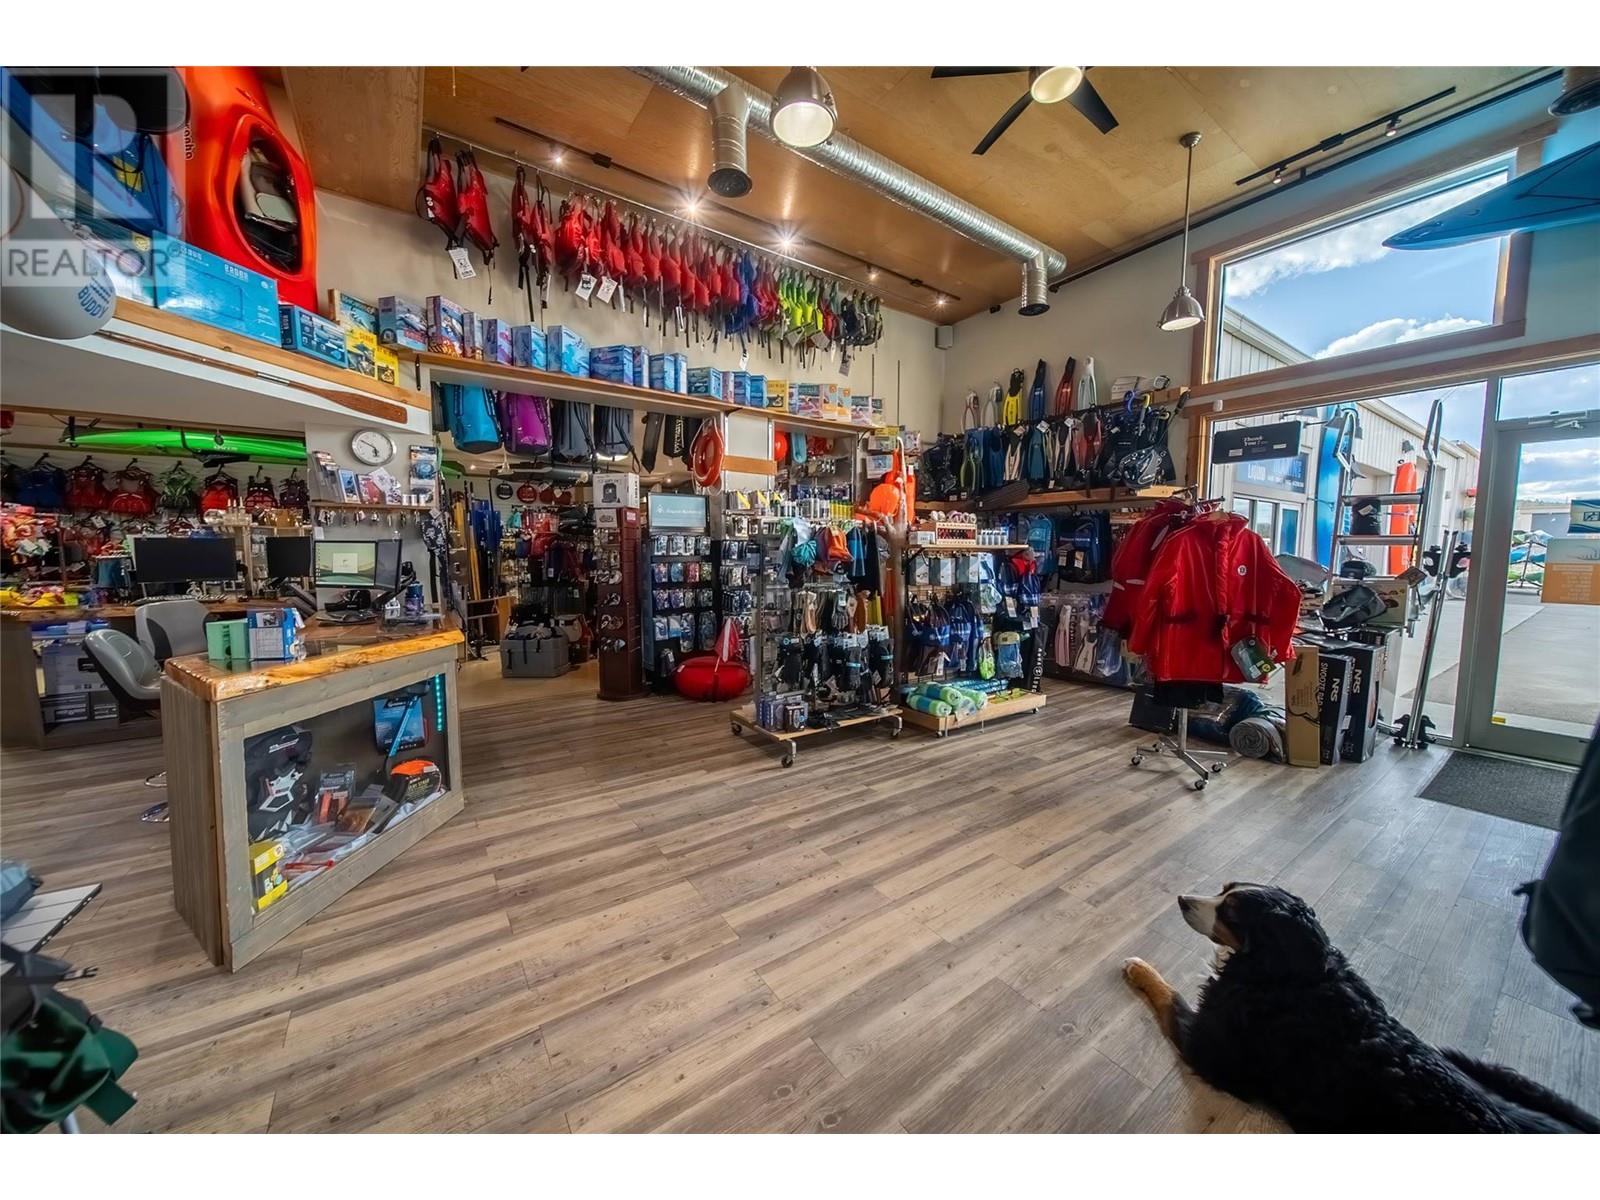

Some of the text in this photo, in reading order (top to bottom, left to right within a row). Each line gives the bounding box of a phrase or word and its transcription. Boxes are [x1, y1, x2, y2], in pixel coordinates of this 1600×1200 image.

[78, 286, 109, 319] BUDDY
[1330, 678, 1341, 703] NRS
[1352, 669, 1362, 694] NRS
